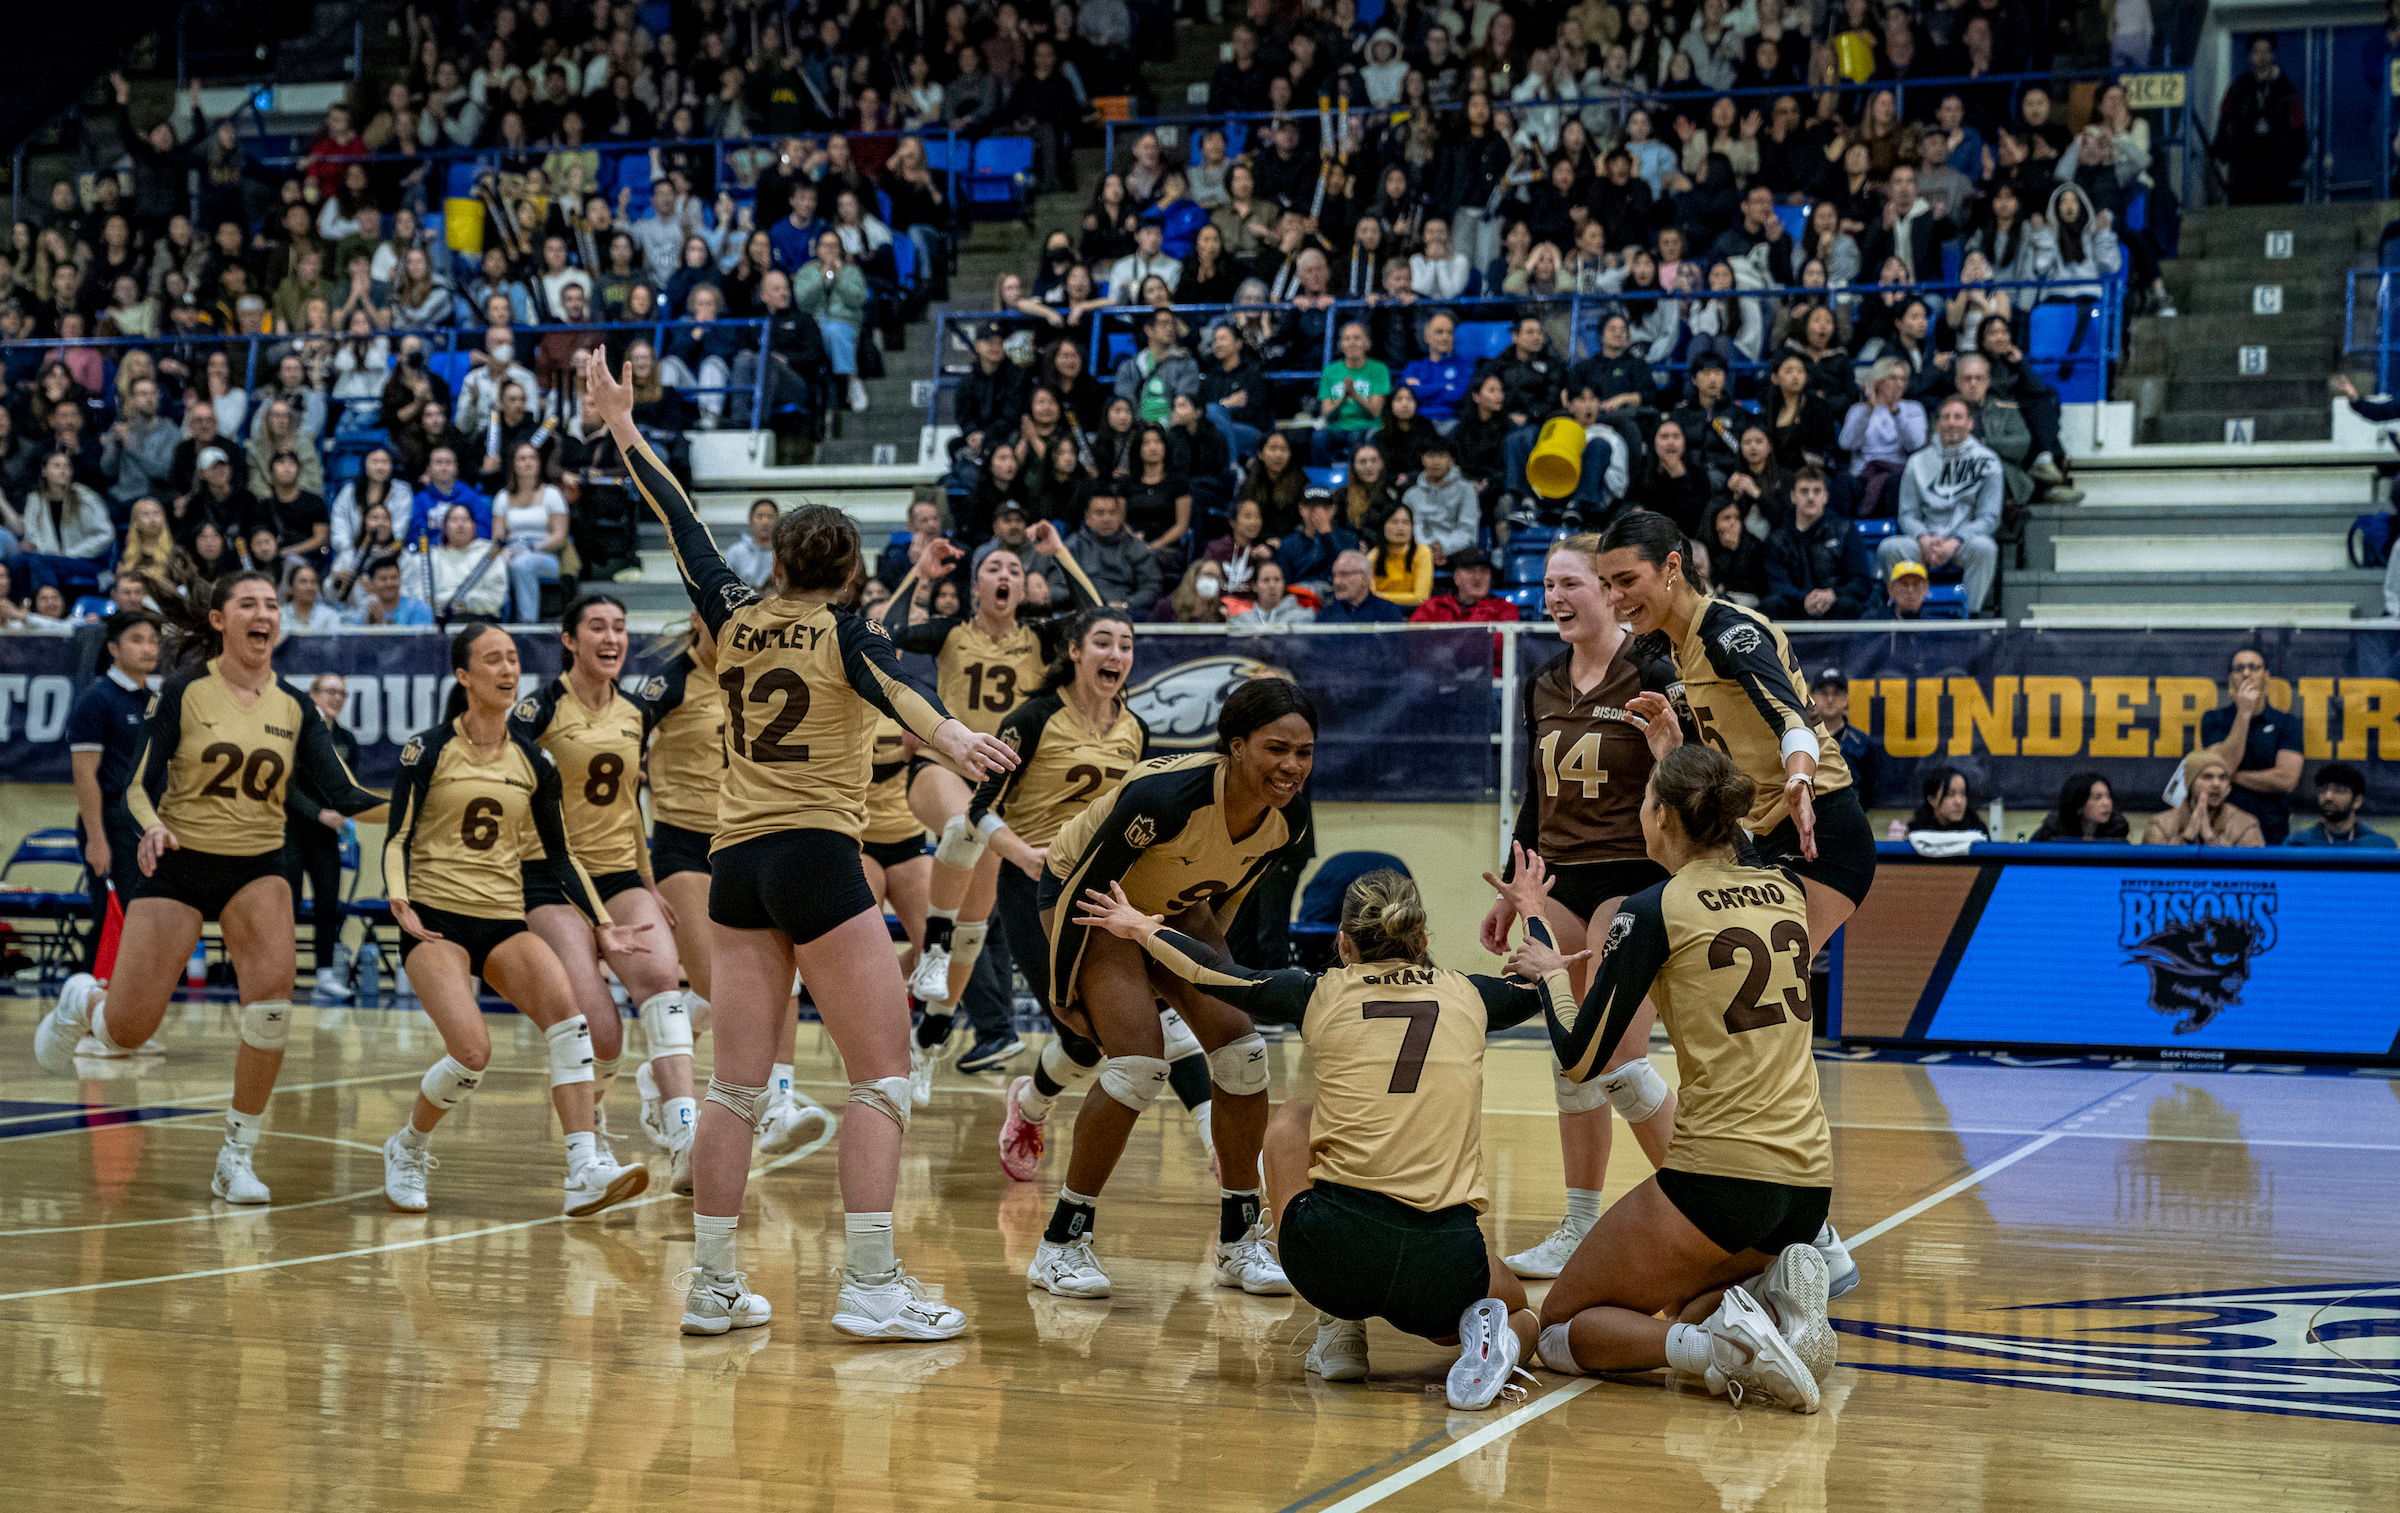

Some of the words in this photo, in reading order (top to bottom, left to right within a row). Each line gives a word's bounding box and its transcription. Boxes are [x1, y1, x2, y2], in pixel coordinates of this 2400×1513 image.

[2273, 233, 2288, 257] D
[2260, 286, 2275, 311] C
[718, 666, 810, 762] 12
[963, 662, 1017, 712] 13
[200, 742, 285, 801] 20
[584, 752, 624, 806] 8
[1539, 729, 1609, 799] 14
[461, 797, 503, 850] 6
[2192, 880, 2208, 889] OF
[2118, 890, 2278, 956] BISONS
[1708, 920, 1812, 1035] 23
[1362, 1001, 1440, 1094] 7
